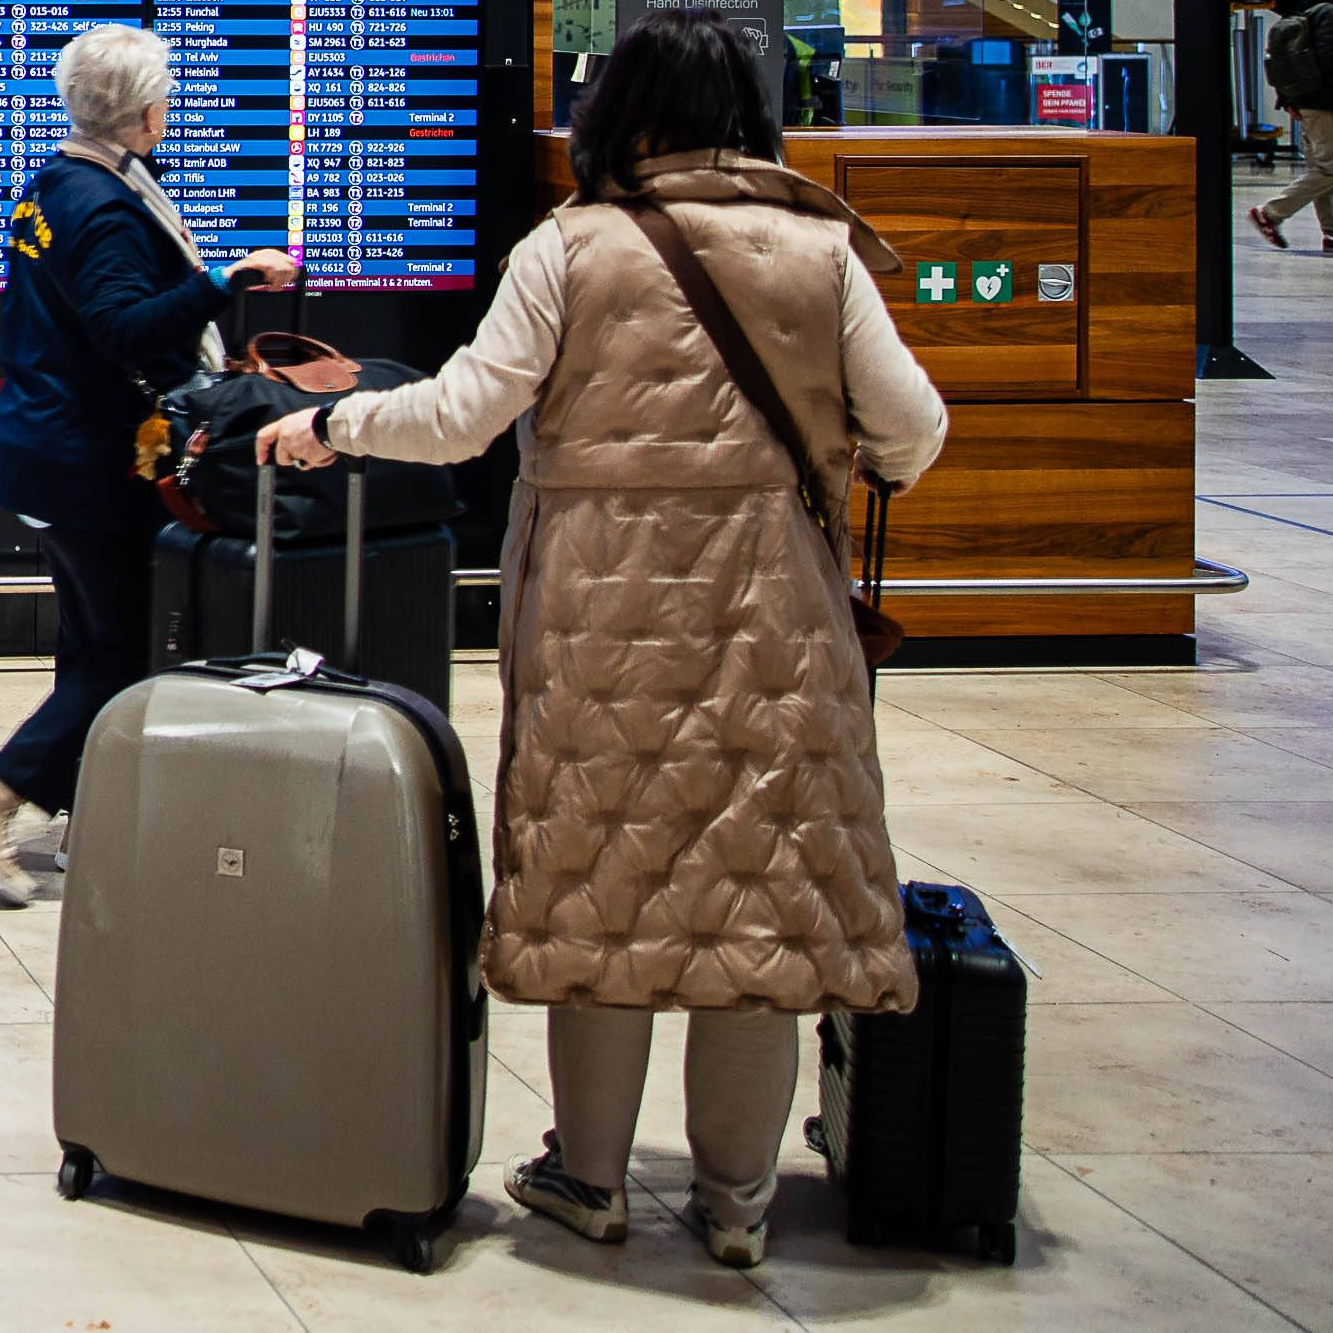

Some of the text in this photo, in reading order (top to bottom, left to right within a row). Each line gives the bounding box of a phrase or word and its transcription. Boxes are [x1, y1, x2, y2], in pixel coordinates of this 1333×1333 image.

[157, 8, 181, 16] 12:55
[186, 7, 218, 16] Funchal
[310, 8, 345, 16] EJU5333
[369, 8, 406, 16] 611-616
